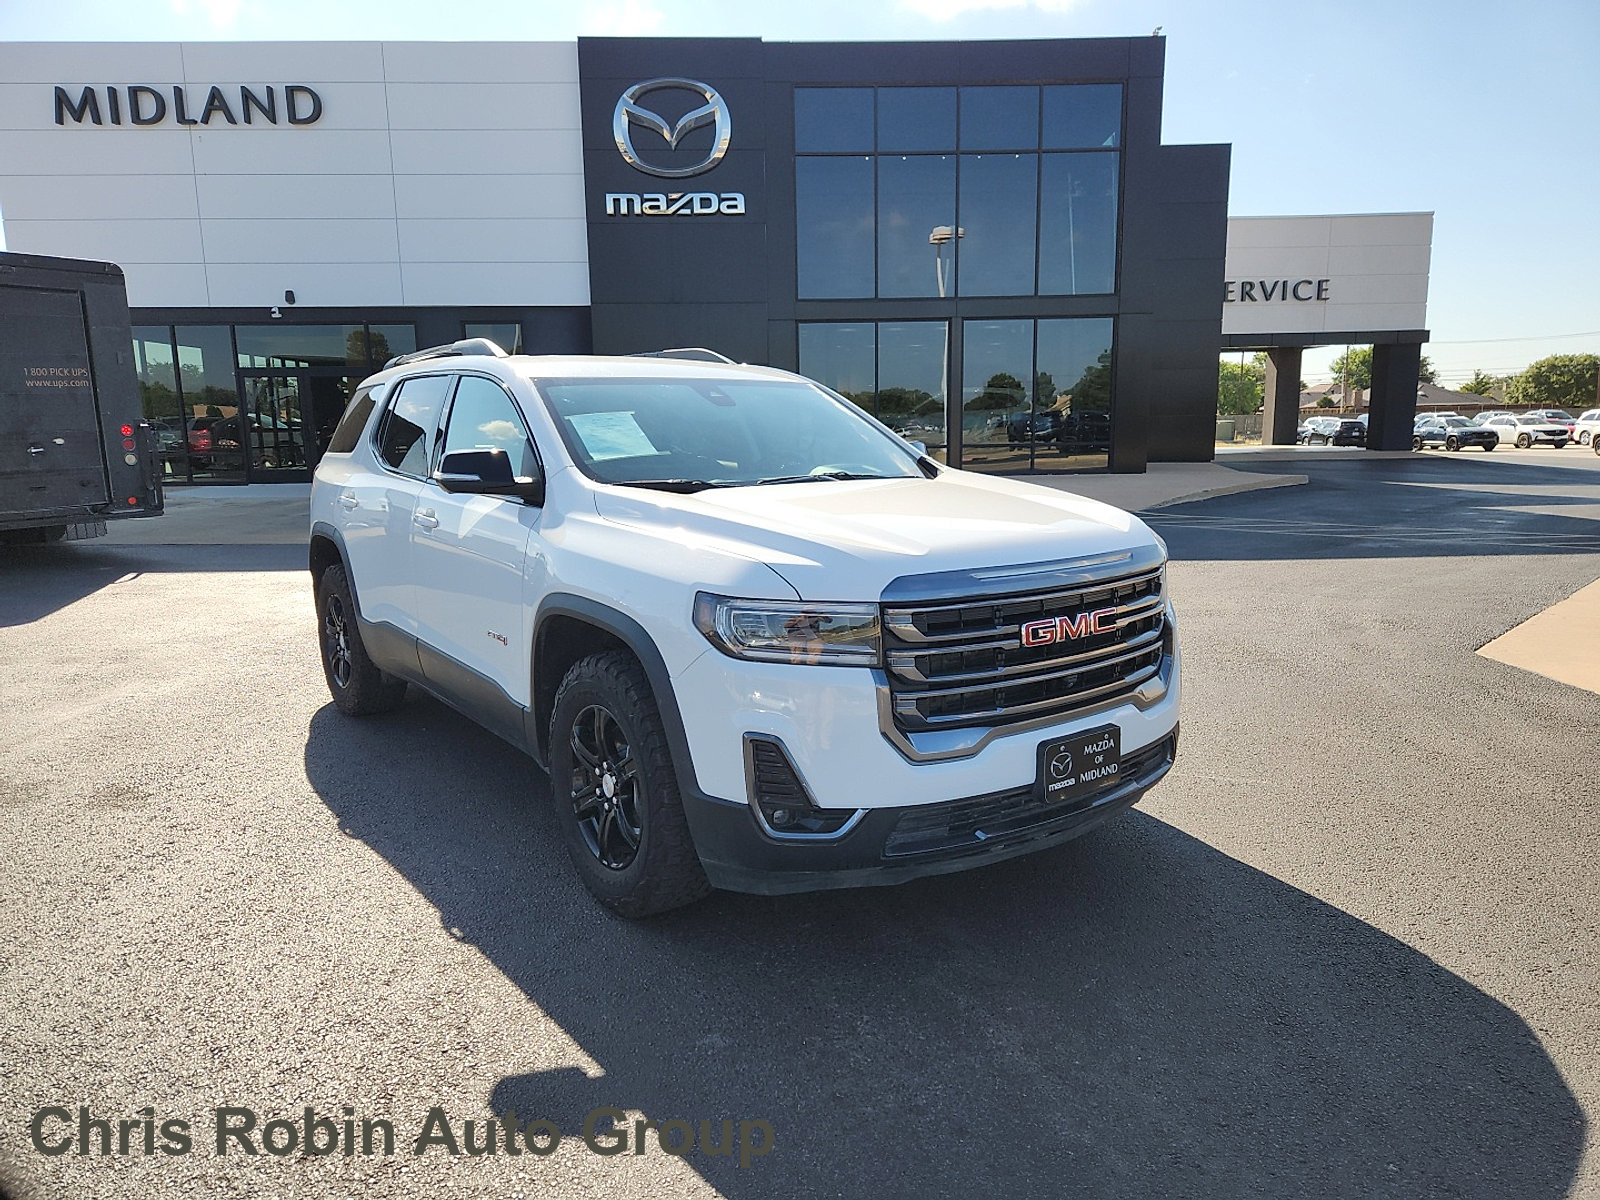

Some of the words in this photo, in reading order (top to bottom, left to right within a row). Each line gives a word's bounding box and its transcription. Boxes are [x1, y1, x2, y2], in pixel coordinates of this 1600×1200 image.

[54, 85, 322, 126] MIDLAND
[605, 192, 746, 216] mazda
[1223, 279, 1330, 303] ERVICE
[30, 367, 48, 376] 800
[49, 367, 70, 376] PICK
[71, 367, 88, 376] UPS
[25, 380, 89, 388] www.ups.com
[1021, 606, 1117, 647] GMC
[1084, 739, 1114, 755] MAZDA
[1094, 754, 1105, 764] OF
[1080, 764, 1118, 783] MIDLAND
